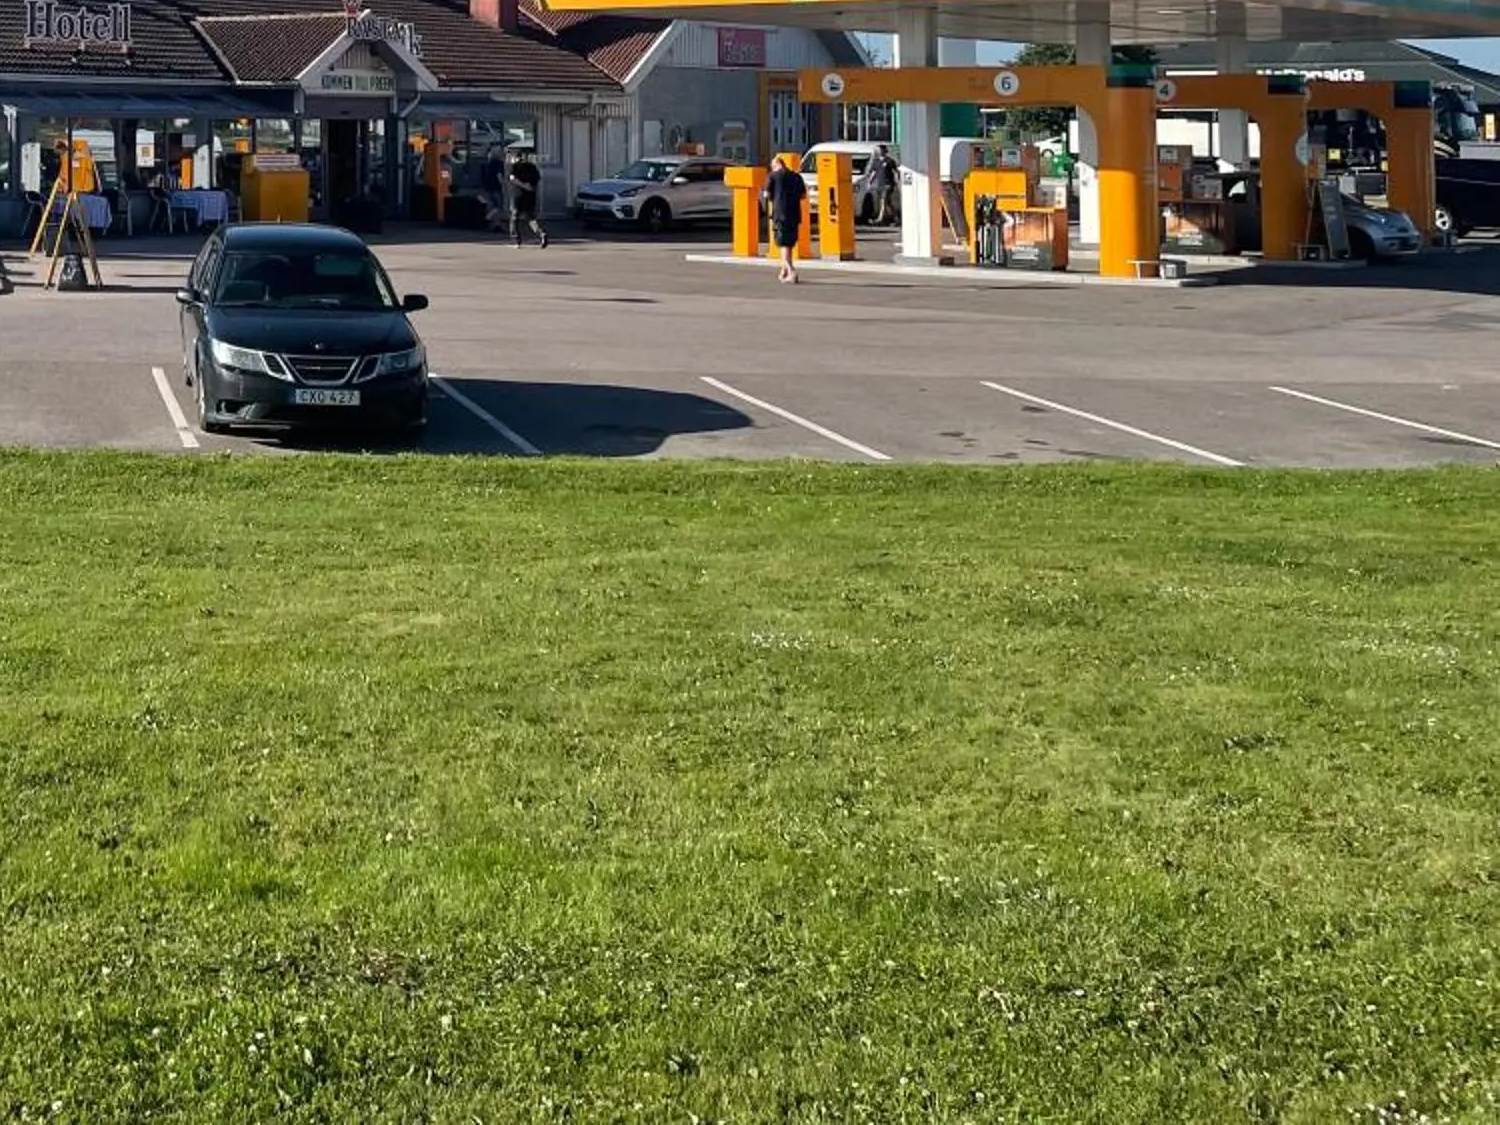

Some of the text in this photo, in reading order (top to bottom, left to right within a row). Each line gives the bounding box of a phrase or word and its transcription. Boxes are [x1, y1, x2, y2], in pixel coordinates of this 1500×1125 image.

[24, 0, 132, 43] Hotell
[1001, 78, 1013, 92] 6
[1159, 83, 1170, 96] 4
